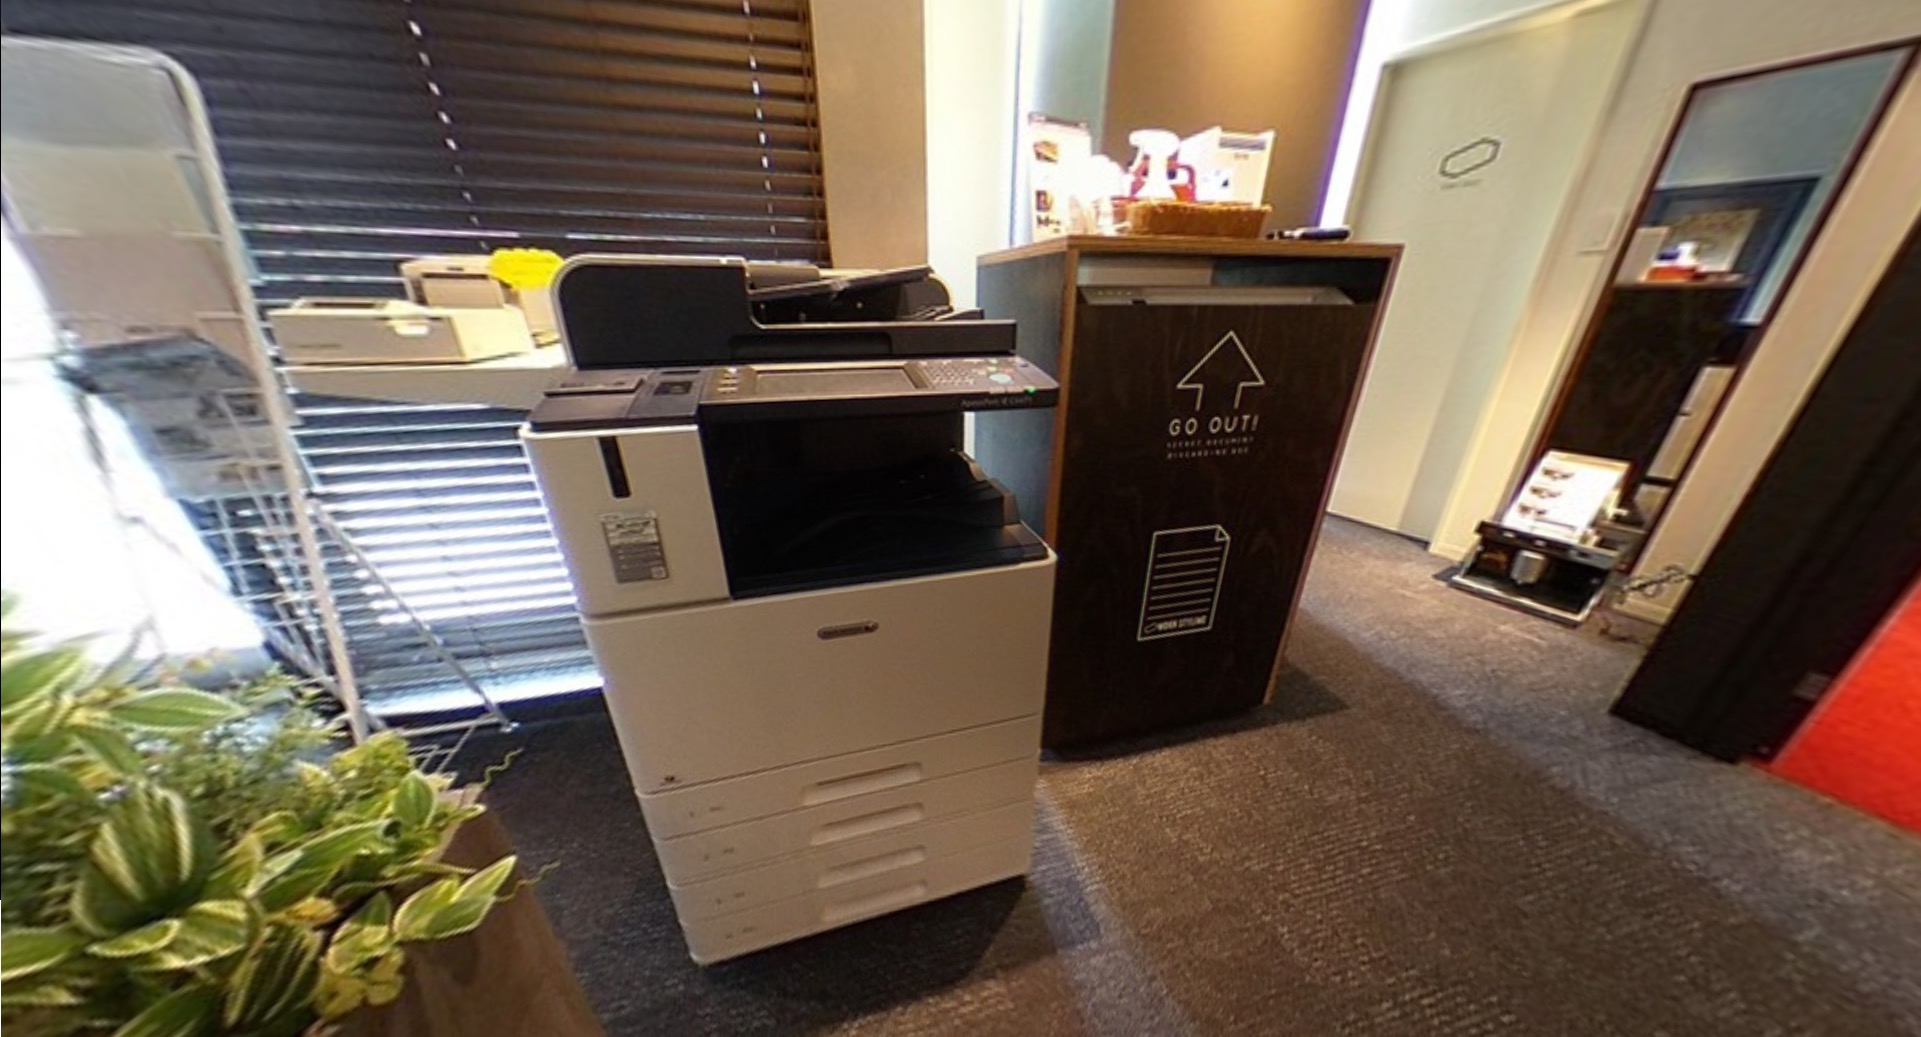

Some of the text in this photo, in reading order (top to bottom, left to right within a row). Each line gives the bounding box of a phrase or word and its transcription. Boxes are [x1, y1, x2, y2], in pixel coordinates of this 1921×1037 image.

[1168, 415, 1259, 436] GO OUT!
[1166, 436, 1254, 449] SECRET DOCUMENT
